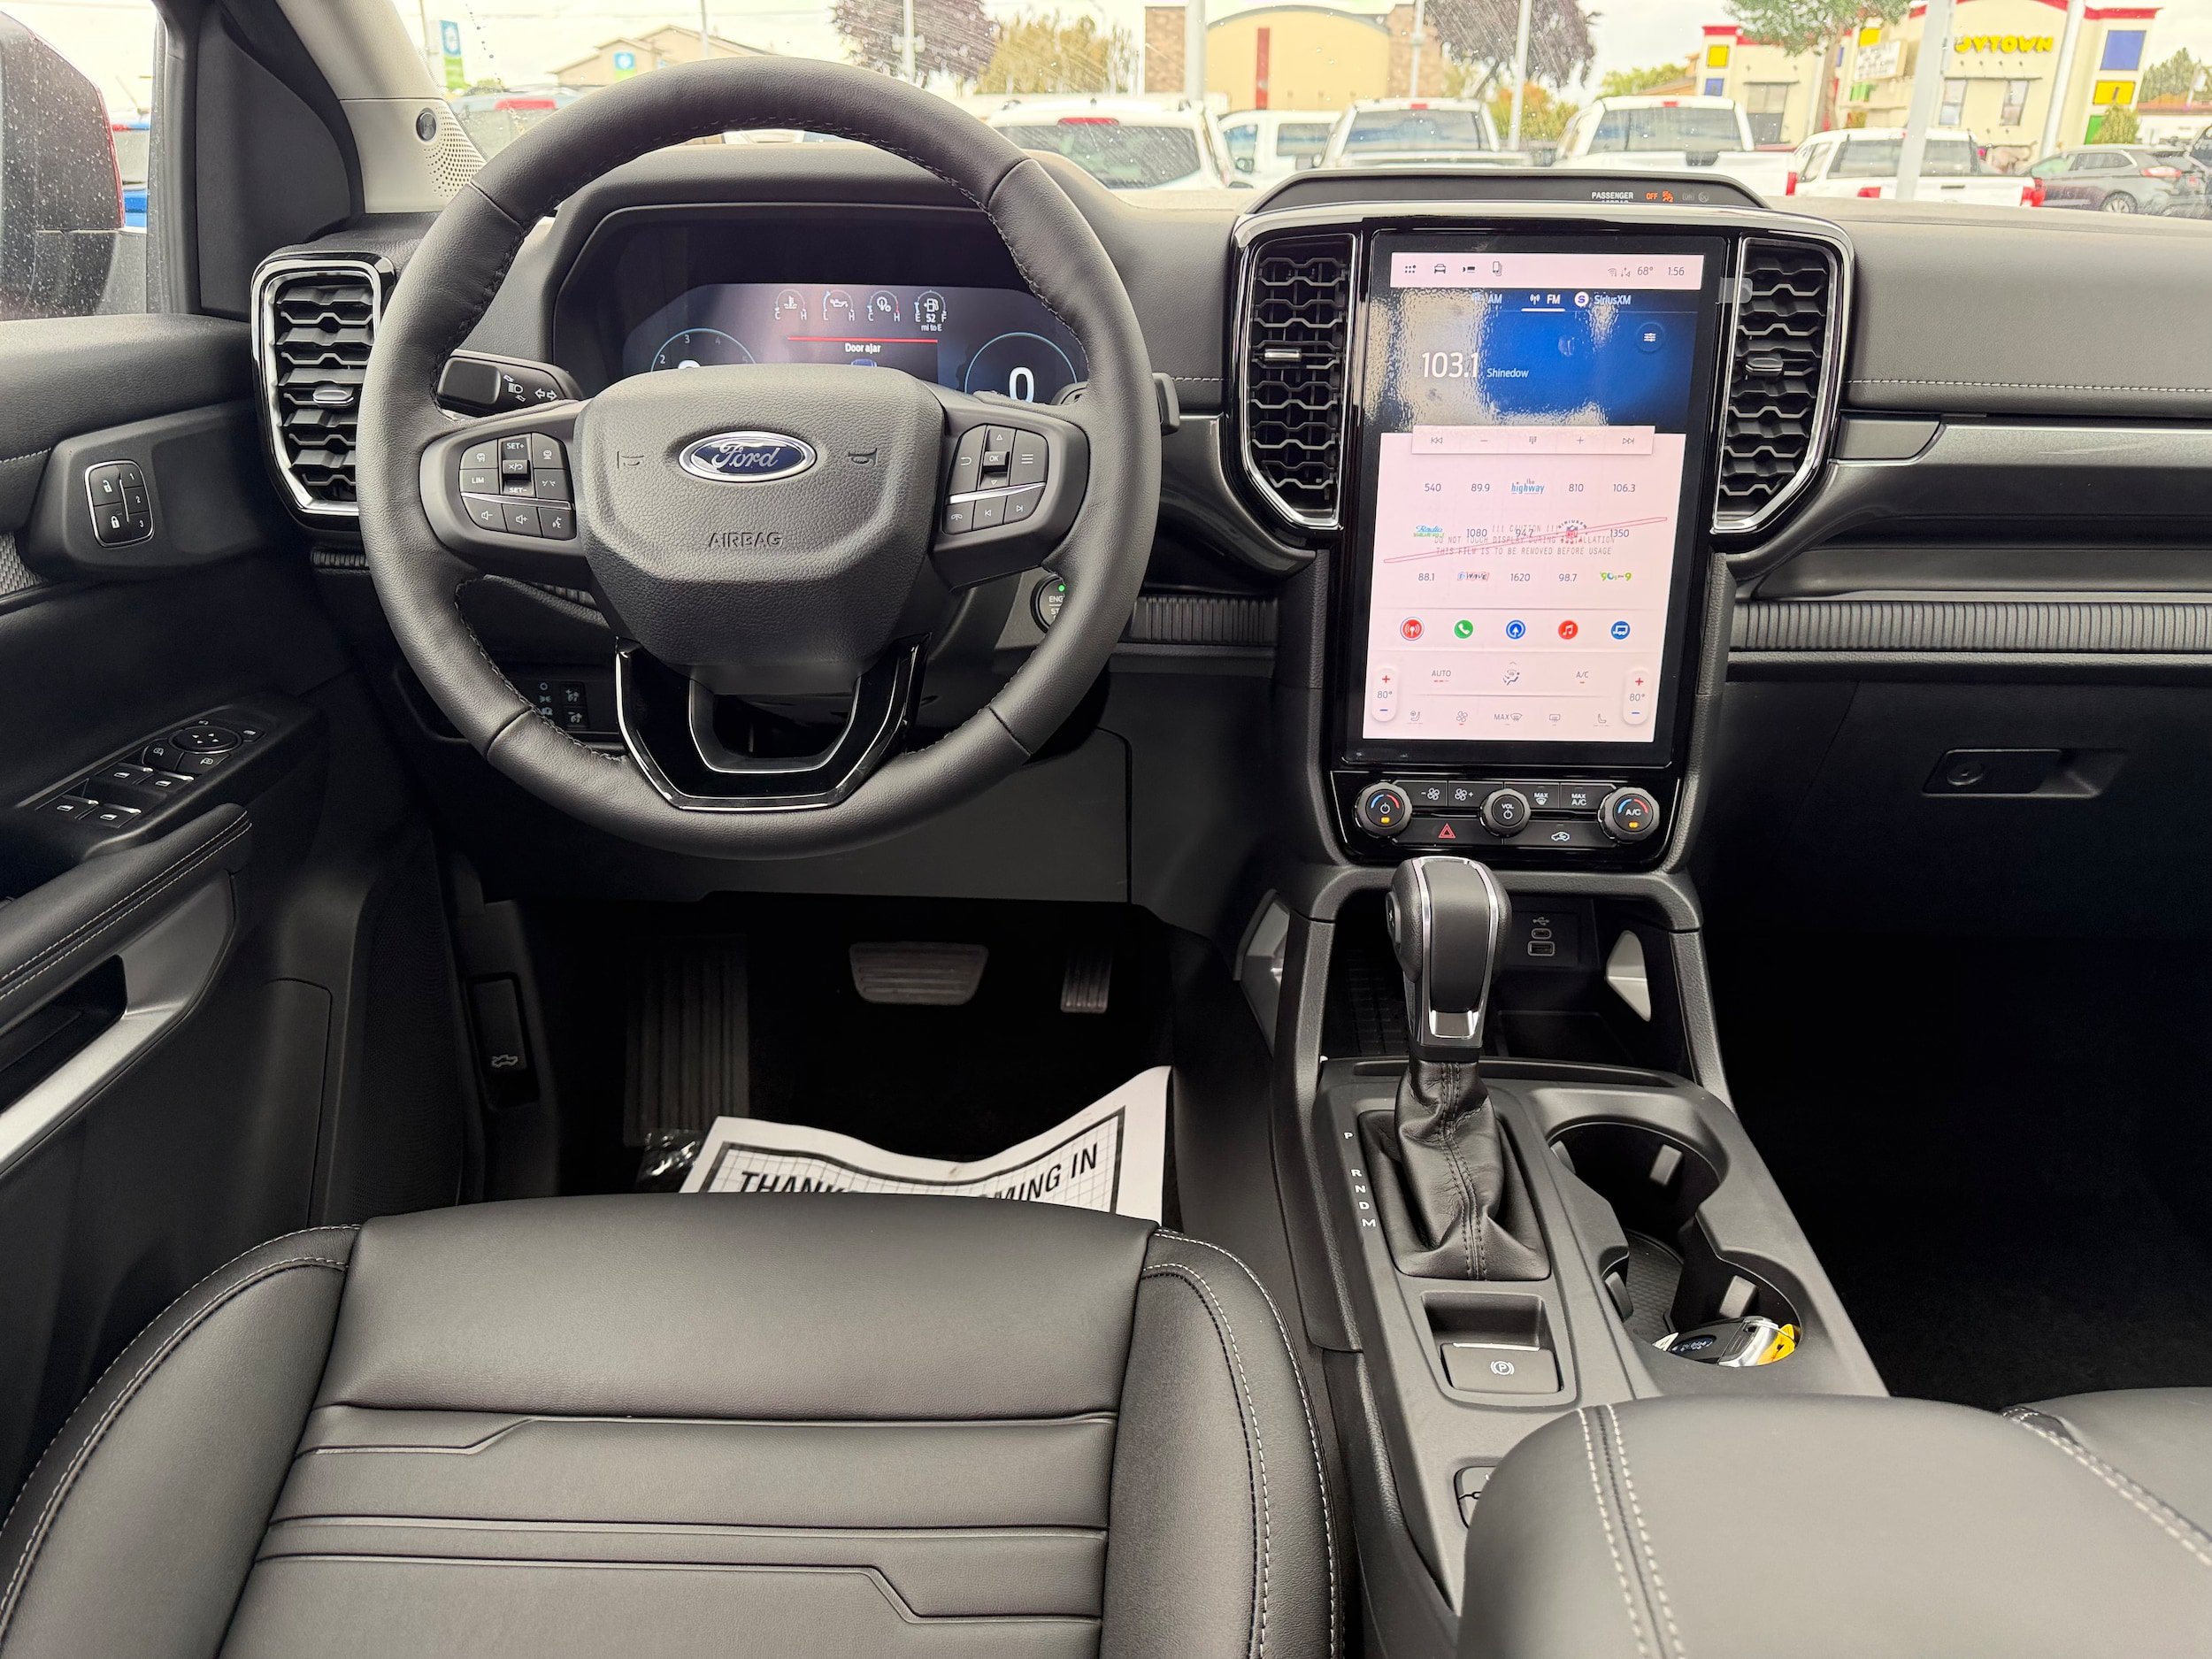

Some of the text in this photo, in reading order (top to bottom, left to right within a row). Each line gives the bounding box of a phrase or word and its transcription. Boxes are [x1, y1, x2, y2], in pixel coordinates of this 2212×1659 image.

[1592, 191, 1633, 200] PASSENGER
[1637, 266, 1686, 277] 68° 1:56
[1487, 295, 1632, 305] AM FM SiriusXM
[774, 311, 807, 320] C H
[824, 311, 855, 321] L H
[868, 312, 901, 322] C H
[915, 312, 947, 322] E 52 F
[684, 334, 690, 344] 3
[715, 336, 721, 345] 4
[845, 342, 881, 355] Door ajar
[659, 354, 666, 365] 2
[1422, 351, 1530, 379] 103.1 Shinedow
[1009, 366, 1034, 403] 0
[711, 442, 780, 469] Ford
[1425, 481, 1636, 494] 540 89.9 highway 810 106.3
[1466, 528, 1487, 538] 1080
[1610, 529, 1630, 538] 1350
[709, 532, 783, 548] AIRBAG
[1417, 572, 1435, 581] 88.1
[1510, 572, 1531, 582] 1620
[1558, 573, 1578, 582] 98.7
[1576, 671, 1589, 680] A/C
[1377, 690, 1393, 699] 80°
[1629, 693, 1645, 702] 80°
[1071, 1142, 1097, 1179] IN
[1351, 1169, 1363, 1178] R
[1355, 1185, 1367, 1194] N
[1359, 1201, 1370, 1210] D
[1362, 1218, 1378, 1228] M
